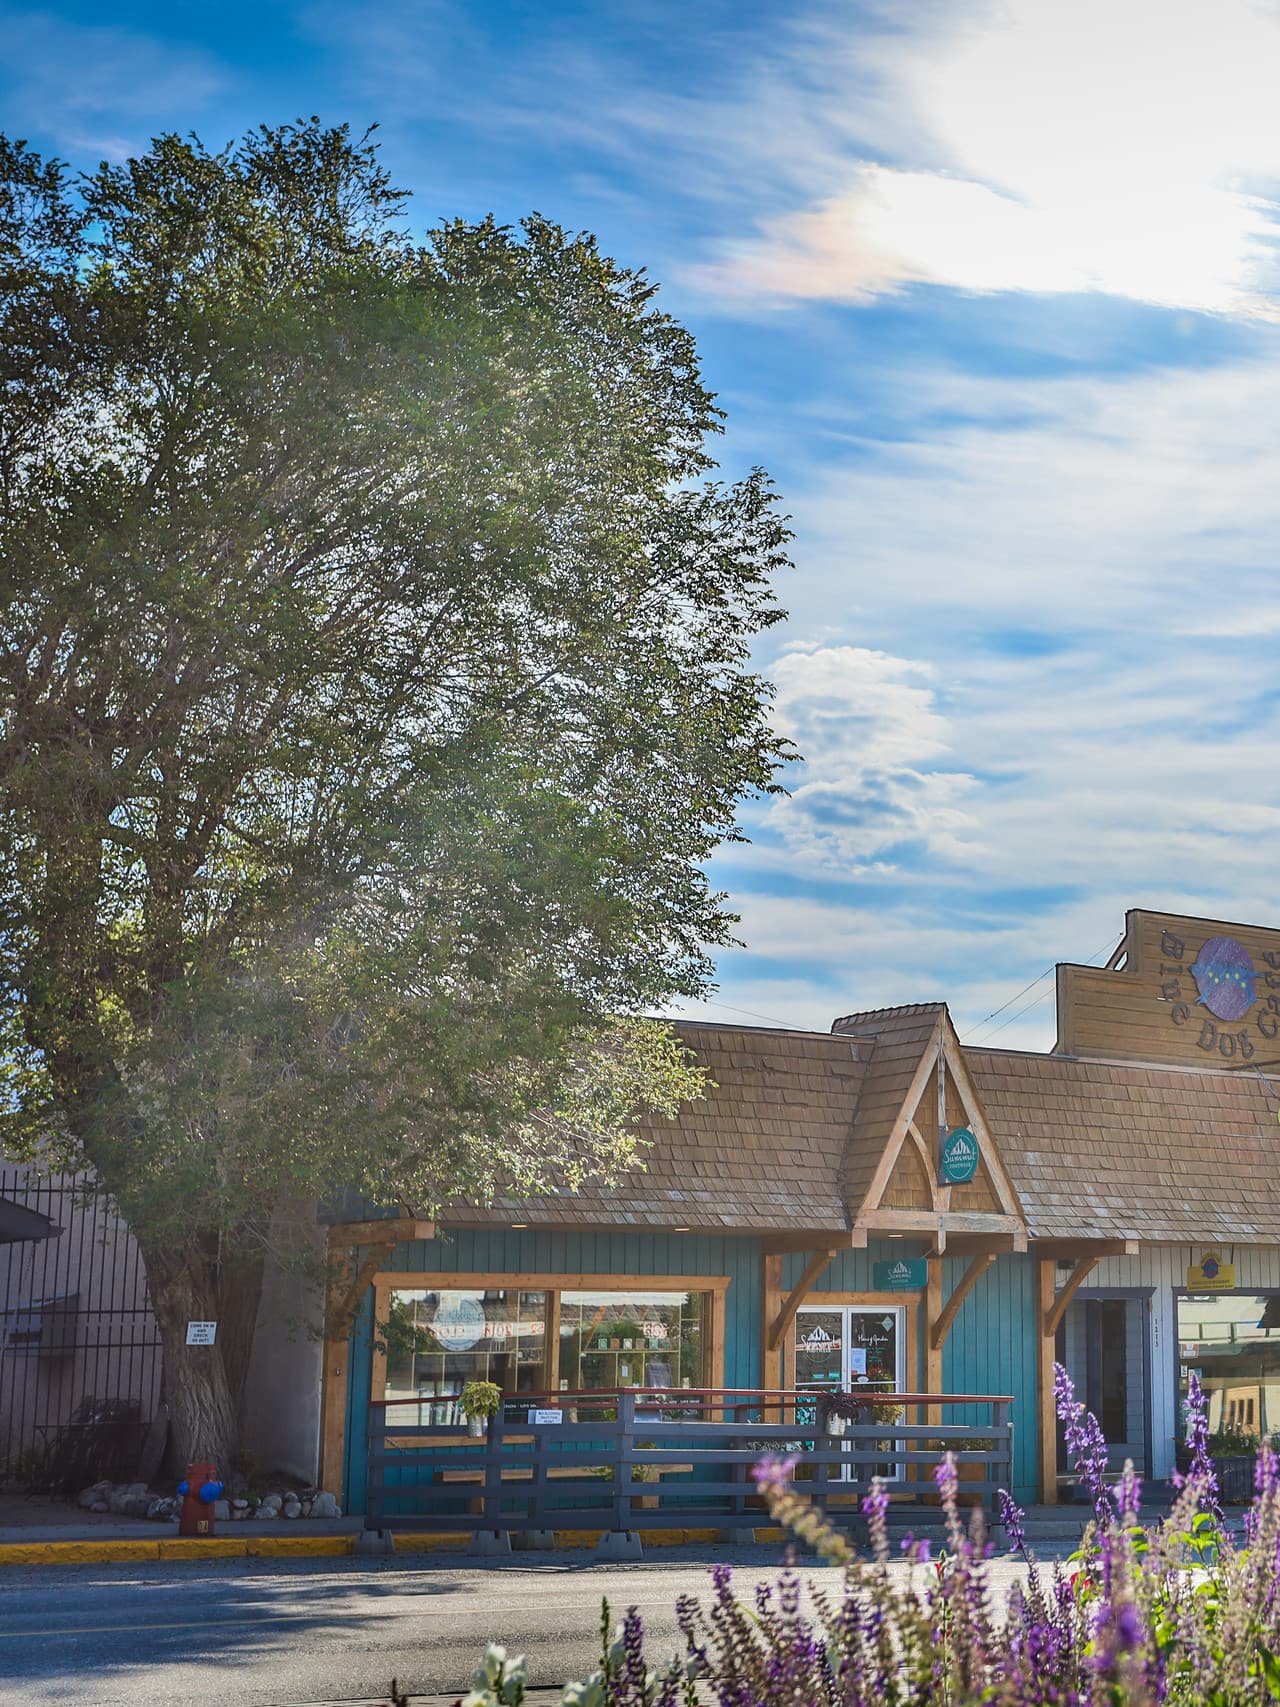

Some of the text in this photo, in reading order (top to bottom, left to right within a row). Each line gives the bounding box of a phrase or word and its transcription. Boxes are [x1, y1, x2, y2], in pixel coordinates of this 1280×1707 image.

[1160, 929, 1191, 1025] Blue
[1197, 1019, 1254, 1058] Dog
[944, 1147, 977, 1164] Summit
